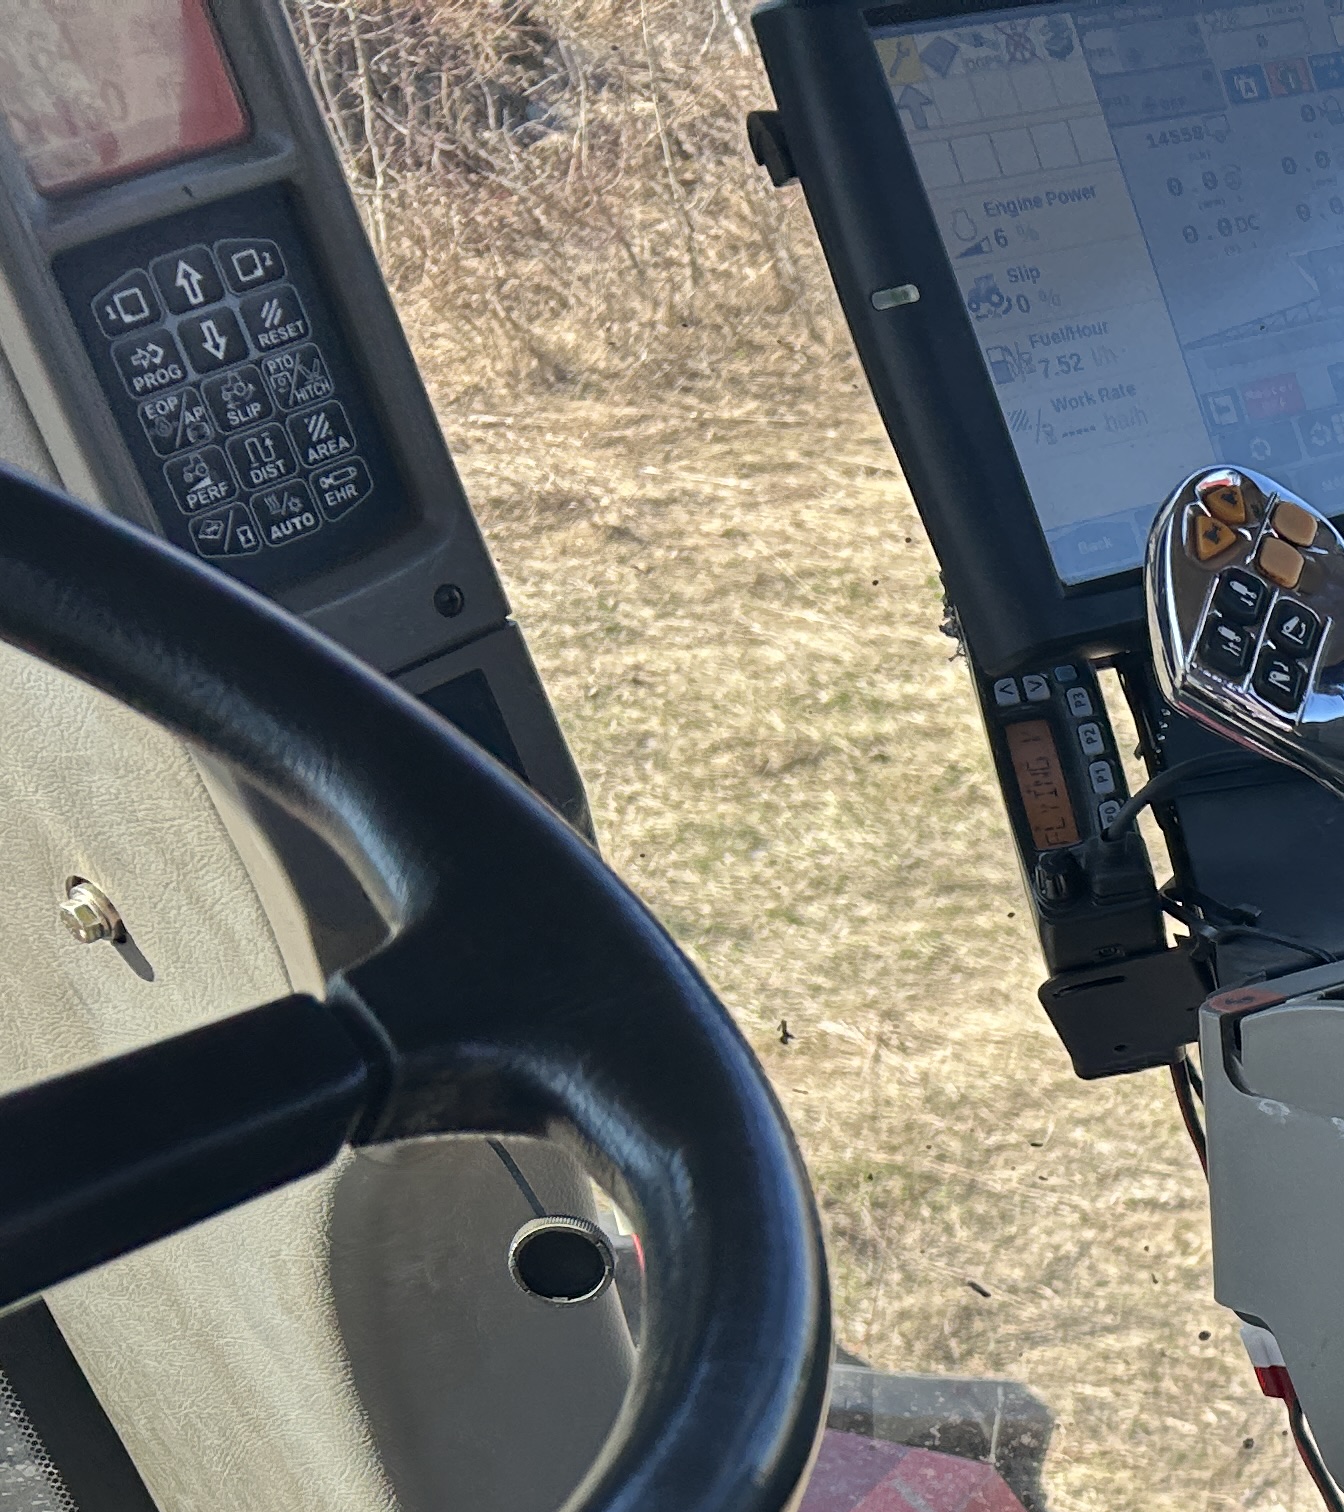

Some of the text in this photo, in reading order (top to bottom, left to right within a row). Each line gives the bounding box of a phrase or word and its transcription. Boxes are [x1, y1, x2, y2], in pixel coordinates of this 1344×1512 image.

[983, 184, 1097, 218] Engine Power
[994, 228, 1009, 248] 6
[262, 251, 273, 266] 2
[1006, 264, 1041, 284] Slip
[105, 304, 116, 320] 1
[1016, 294, 1031, 314] 0
[258, 320, 304, 347] RESET
[1028, 321, 1110, 349] Fuel/Hour
[268, 354, 293, 374] PTO
[1038, 353, 1085, 379] 7.52
[132, 364, 182, 392] PROG
[295, 380, 331, 401] HITCH
[1050, 383, 1137, 413] Work Rate
[145, 396, 178, 420] EOP
[227, 402, 261, 425] SLIP
[307, 436, 349, 462] AREA
[250, 460, 286, 484] DIST
[186, 481, 229, 508] PERF
[325, 485, 358, 505] EHR
[270, 512, 315, 539] AUTO
[1072, 692, 1088, 708] P3
[1084, 727, 1098, 745] P2
[1097, 767, 1109, 784] P1
